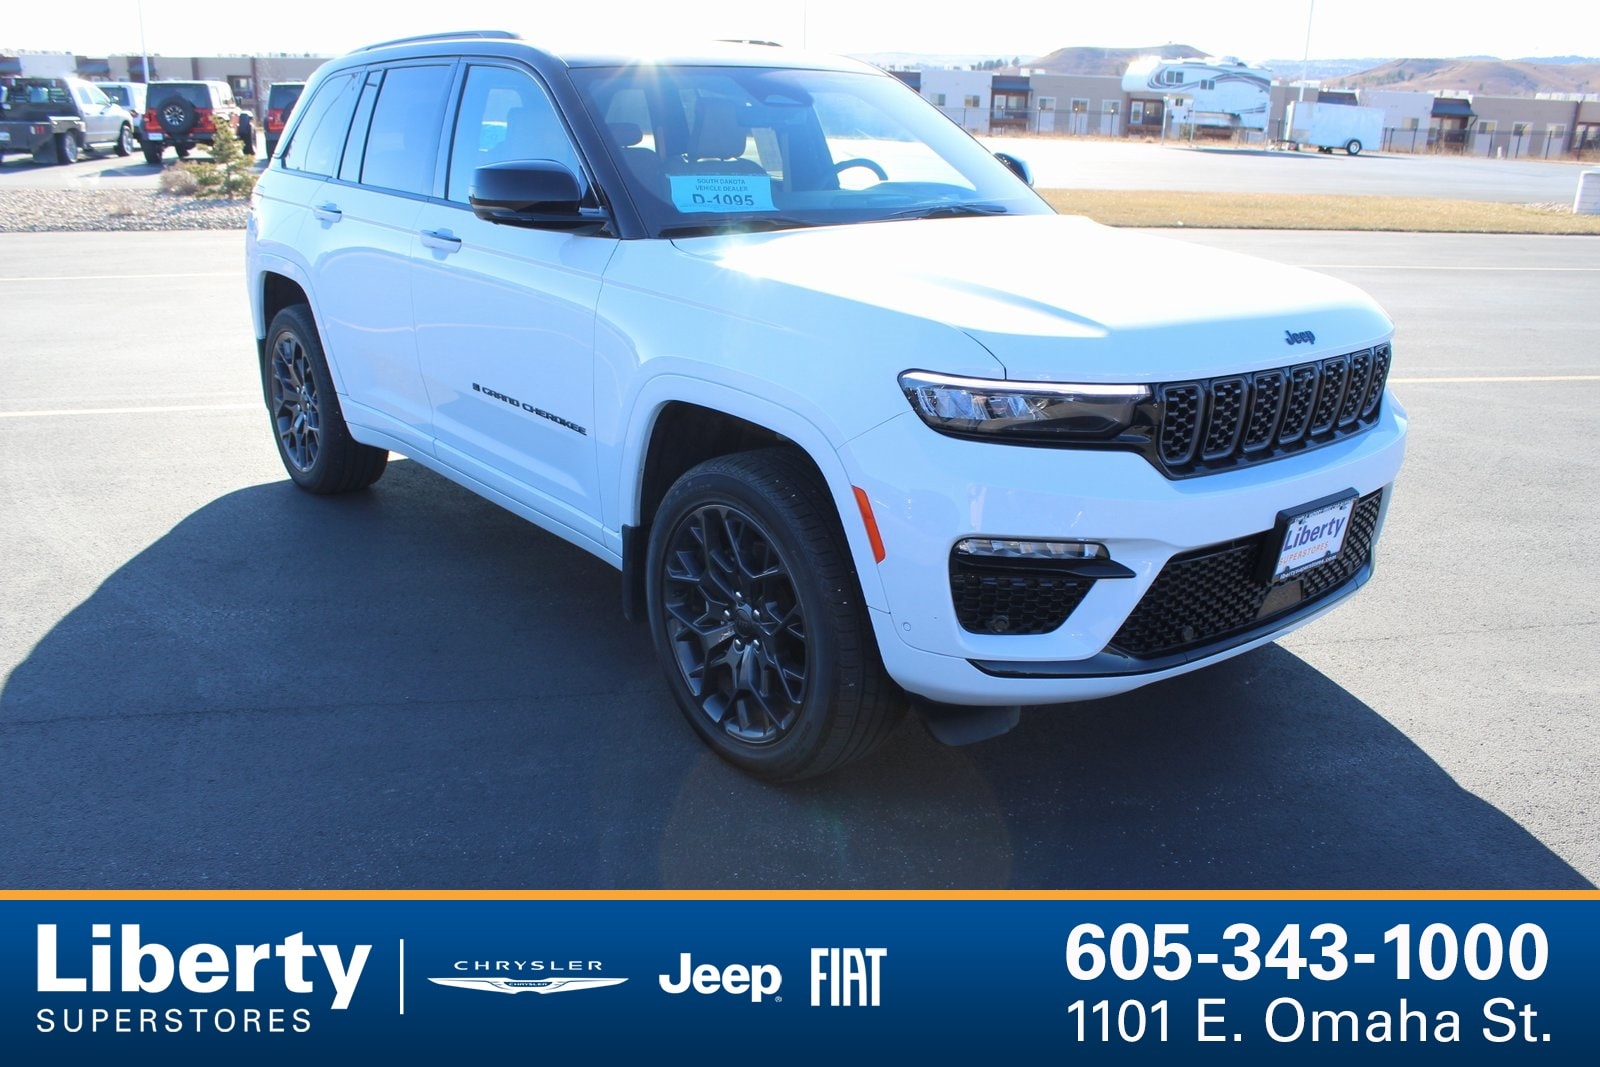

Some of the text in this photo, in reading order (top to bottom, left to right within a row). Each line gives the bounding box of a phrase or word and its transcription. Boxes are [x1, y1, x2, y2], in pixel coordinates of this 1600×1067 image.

[692, 193, 755, 207] D-1095
[1284, 329, 1316, 346] Jeep
[482, 386, 587, 436] GRAND CHEROKEE
[1283, 516, 1346, 552] Liberty
[1279, 540, 1329, 565] SUPERSTORES
